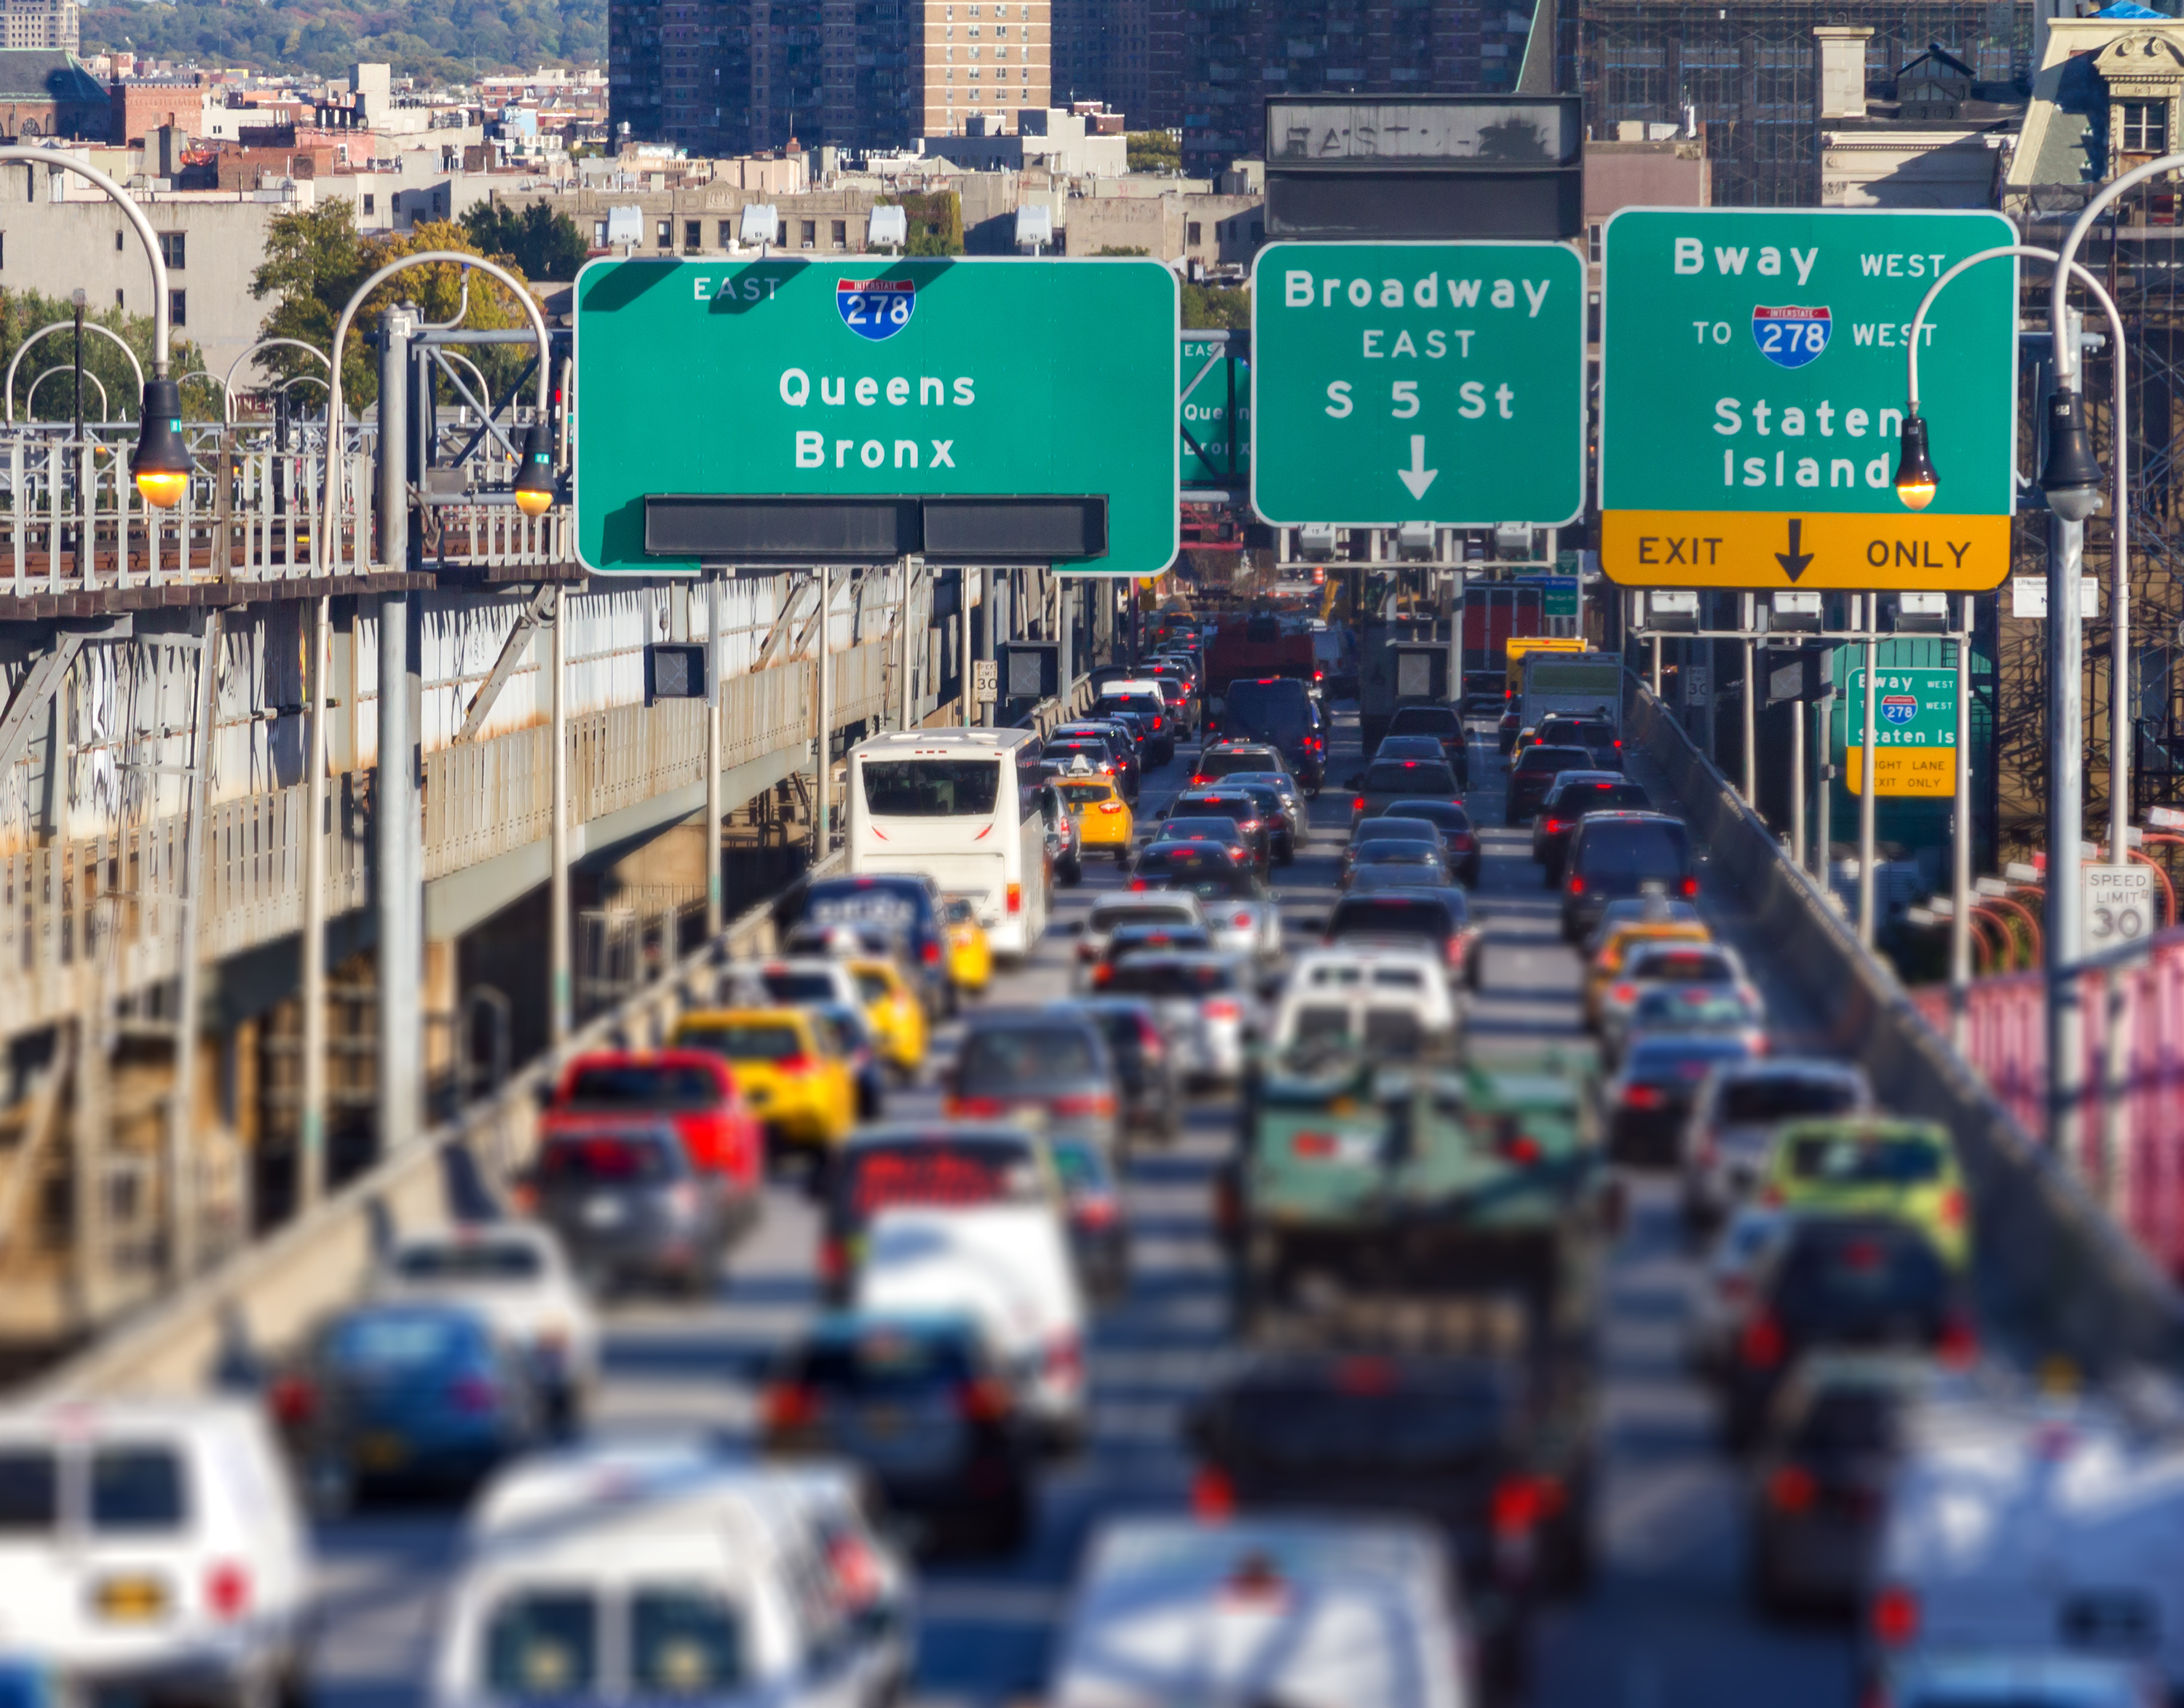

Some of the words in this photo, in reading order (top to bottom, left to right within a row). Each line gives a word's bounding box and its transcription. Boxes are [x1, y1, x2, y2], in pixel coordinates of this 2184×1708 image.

[1674, 237, 1819, 286] Bway
[1860, 253, 1946, 278] WEST
[694, 277, 780, 301] EAST
[854, 281, 898, 290] INTERSTATE
[1285, 270, 1550, 317] Broadway
[847, 294, 909, 325] 278
[1770, 309, 1814, 318] INTERSTATE
[1363, 330, 1476, 358] EAST
[1693, 321, 1732, 344] TO
[1762, 323, 1825, 352] 278
[1853, 323, 1938, 347] WEST
[779, 368, 976, 408] Queens
[1325, 380, 1353, 419] S
[1391, 381, 1420, 419] 5
[1458, 381, 1514, 419] St
[1713, 398, 1903, 438] Staten
[795, 430, 957, 468] Bronx
[1724, 449, 1891, 489] Island
[1639, 537, 1723, 565] EXIT
[1867, 540, 1971, 569] ONLY
[978, 678, 997, 690] 30
[1927, 680, 1954, 689] WEST
[1887, 706, 1913, 719] 278
[1926, 701, 1953, 710] WEST
[1938, 729, 1955, 743] Is
[1875, 761, 1902, 770] IGHT
[1912, 761, 1944, 770] LANE
[1907, 778, 1941, 788] ONLY
[2090, 874, 2146, 887] SPEED
[2096, 891, 2139, 904] LIMIT
[2092, 907, 2143, 939] 30
